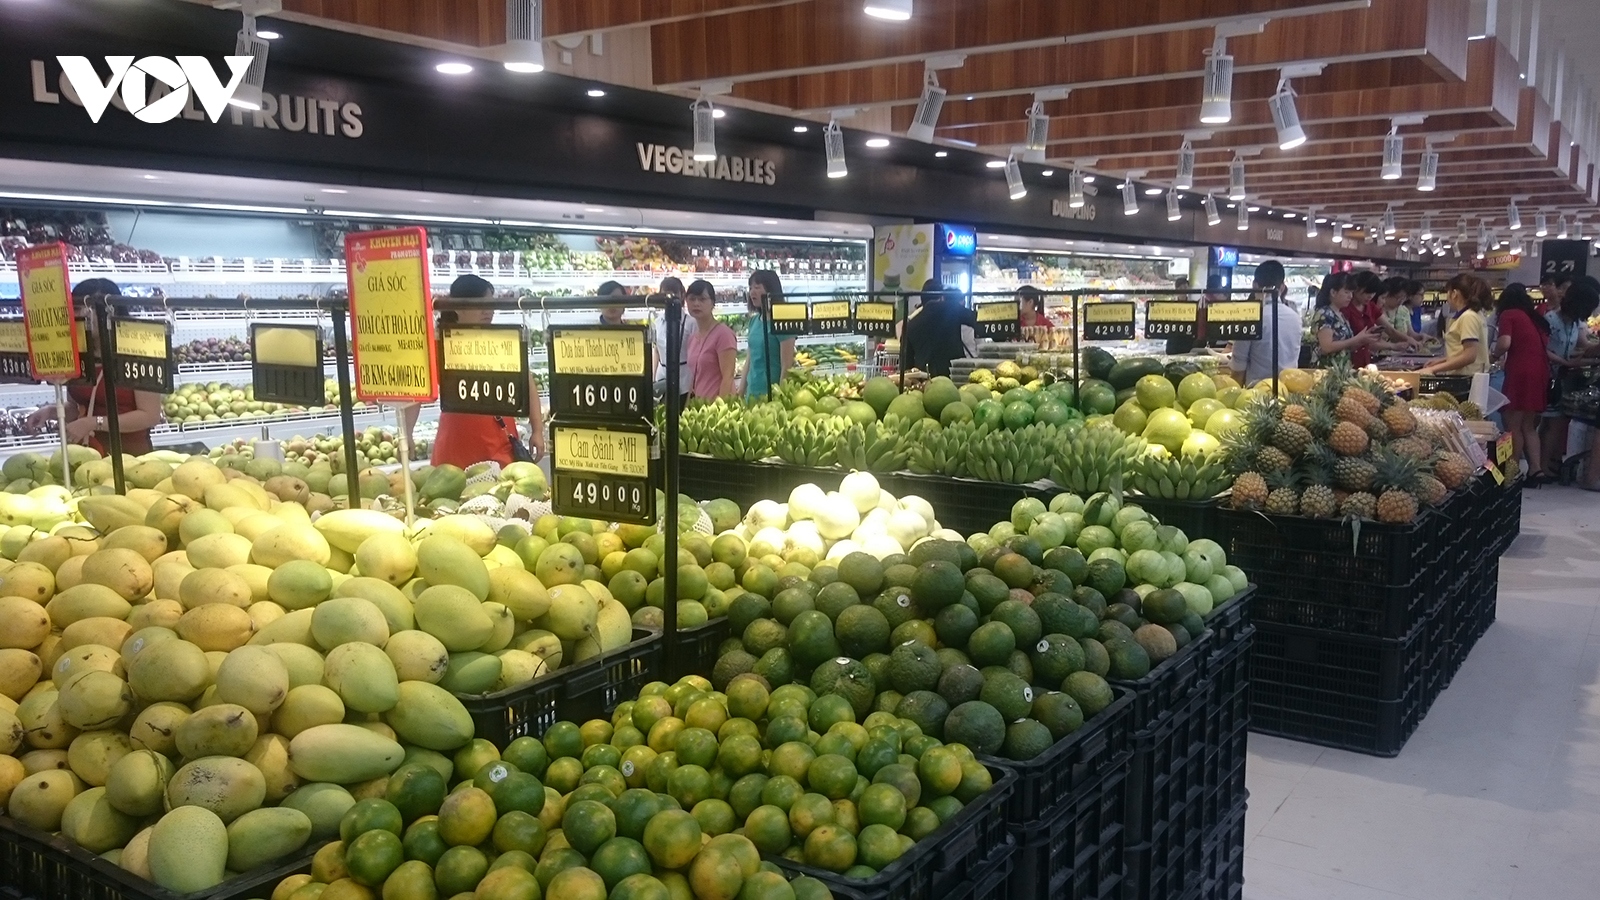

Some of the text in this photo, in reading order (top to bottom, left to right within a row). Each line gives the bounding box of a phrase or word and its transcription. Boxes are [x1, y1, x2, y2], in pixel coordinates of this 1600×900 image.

[1545, 260, 1556, 273] 2
[367, 271, 385, 292] GIÁ
[124, 362, 163, 379] 35000
[360, 364, 370, 385] GB
[458, 379, 515, 401] 64000
[572, 384, 637, 407] 16000
[569, 432, 589, 459] Cam
[592, 433, 614, 461] Sành
[573, 482, 640, 504] 49000
